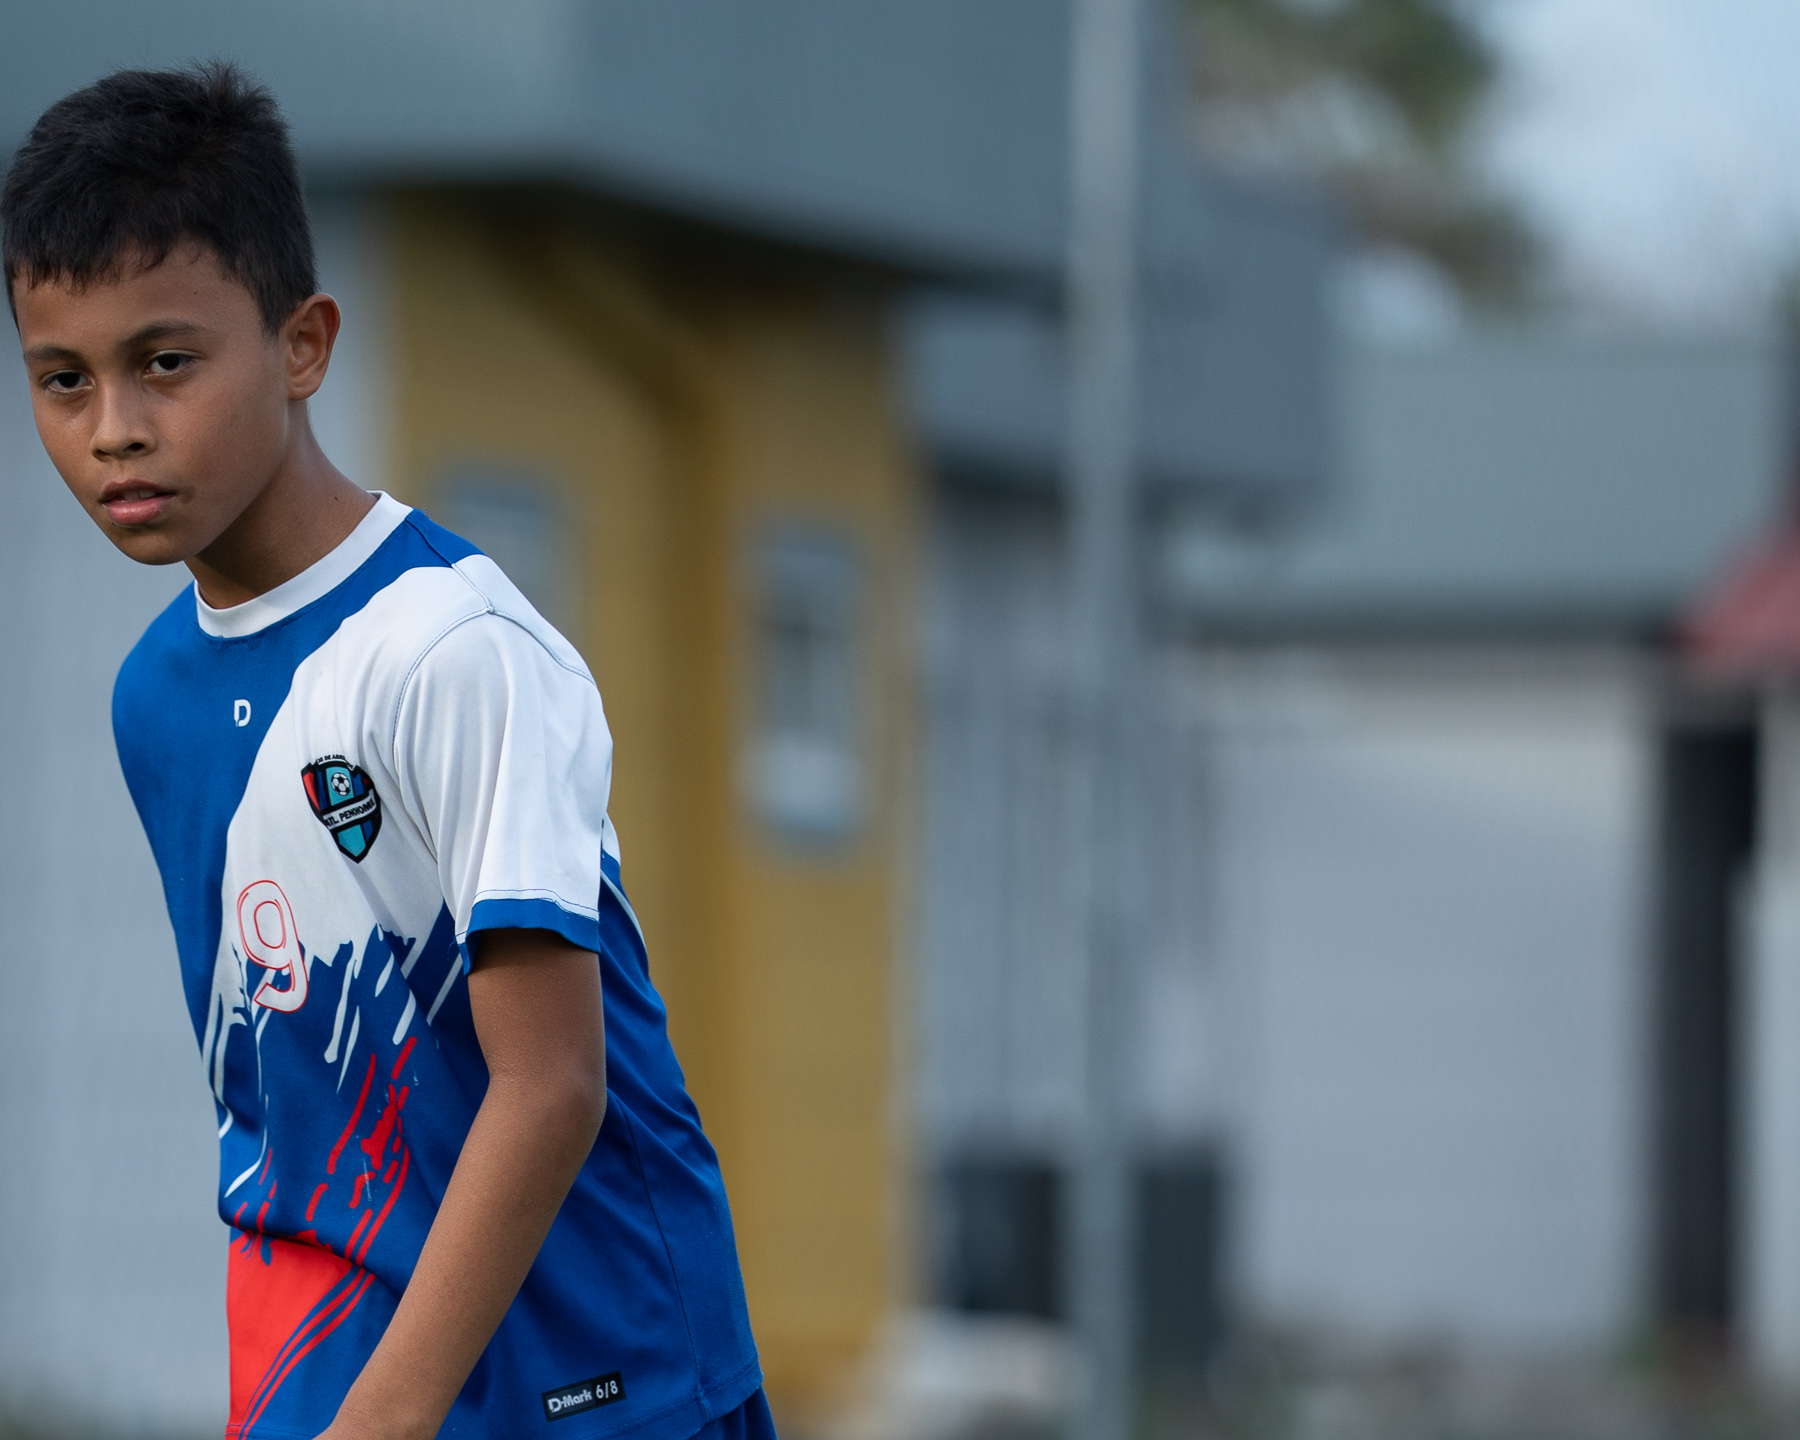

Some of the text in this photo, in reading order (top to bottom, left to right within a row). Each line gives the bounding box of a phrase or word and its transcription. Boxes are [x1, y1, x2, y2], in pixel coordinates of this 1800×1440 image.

[233, 698, 252, 728] D
[236, 879, 309, 1014] 9
[595, 1380, 619, 1399] 6/8
